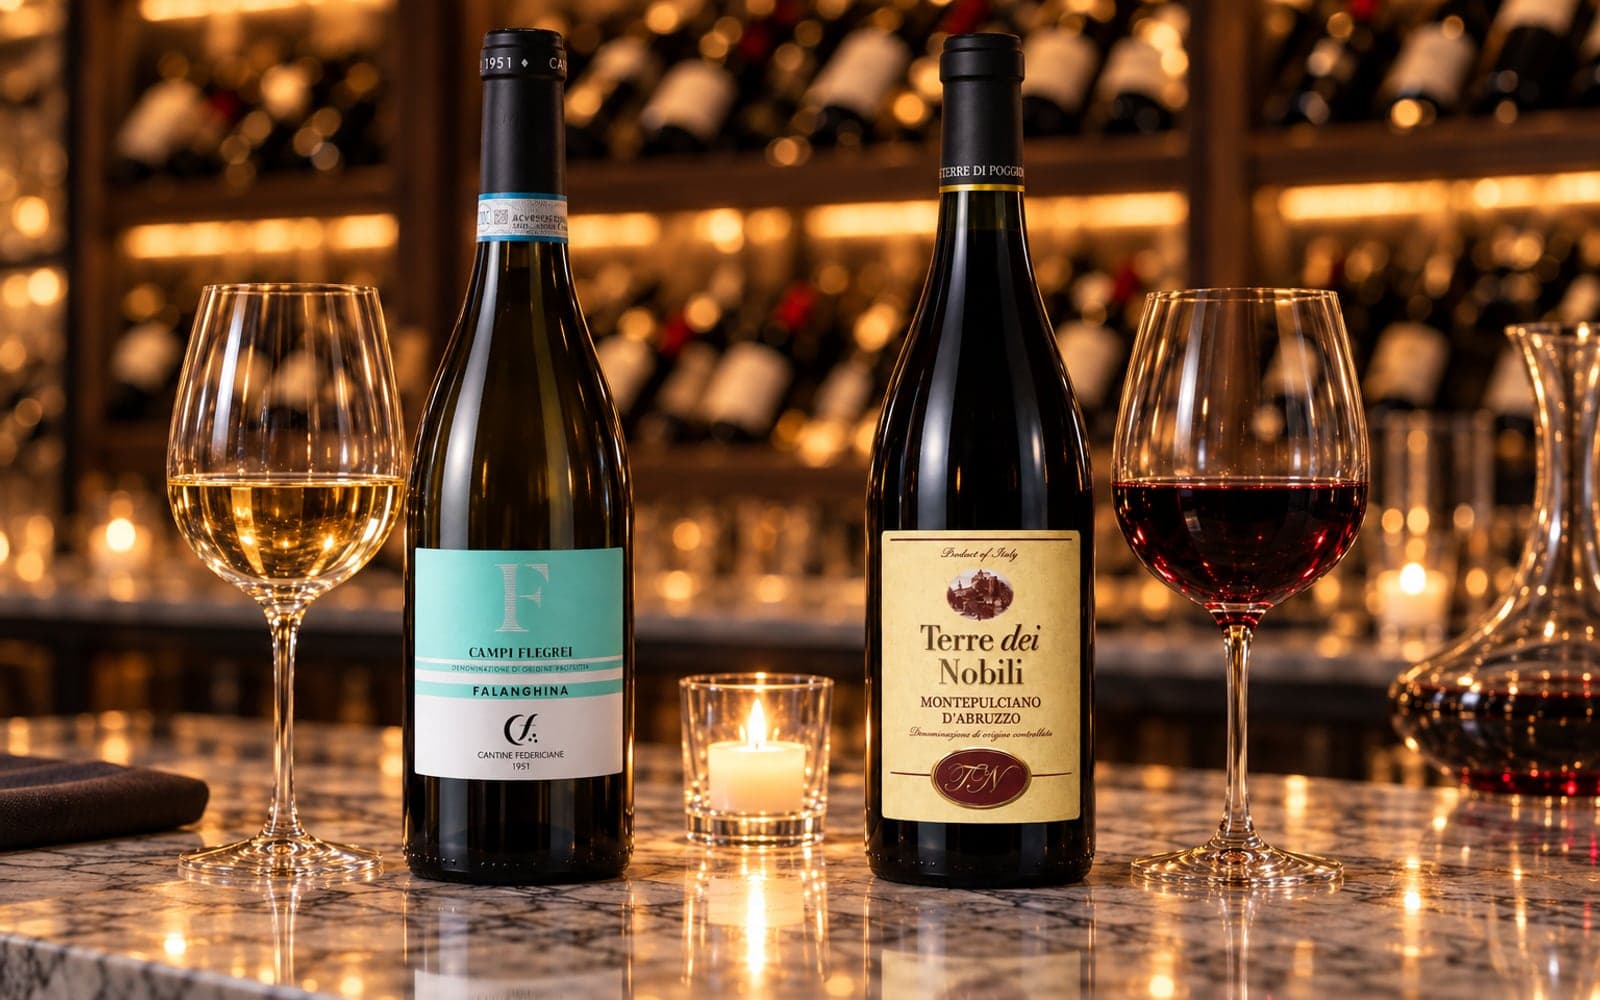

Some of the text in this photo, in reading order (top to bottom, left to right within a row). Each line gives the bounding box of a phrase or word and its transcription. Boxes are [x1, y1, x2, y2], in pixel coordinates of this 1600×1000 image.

[485, 57, 511, 70] 1951
[973, 165, 985, 176] DI
[941, 547, 1018, 562] Product of Italy
[495, 563, 549, 632] F
[920, 624, 1041, 651] Terre dei
[469, 646, 573, 658] CAMPI FLEGREI
[939, 658, 1024, 685] Nobili
[473, 685, 569, 697] FALANGHINA
[920, 696, 1041, 709] MONTEPULCIANO
[943, 712, 1021, 725] D'ABRUZZO
[972, 729, 981, 738] di
[477, 750, 564, 760] CANTINE FEDERICIANE
[512, 762, 530, 771] 1951
